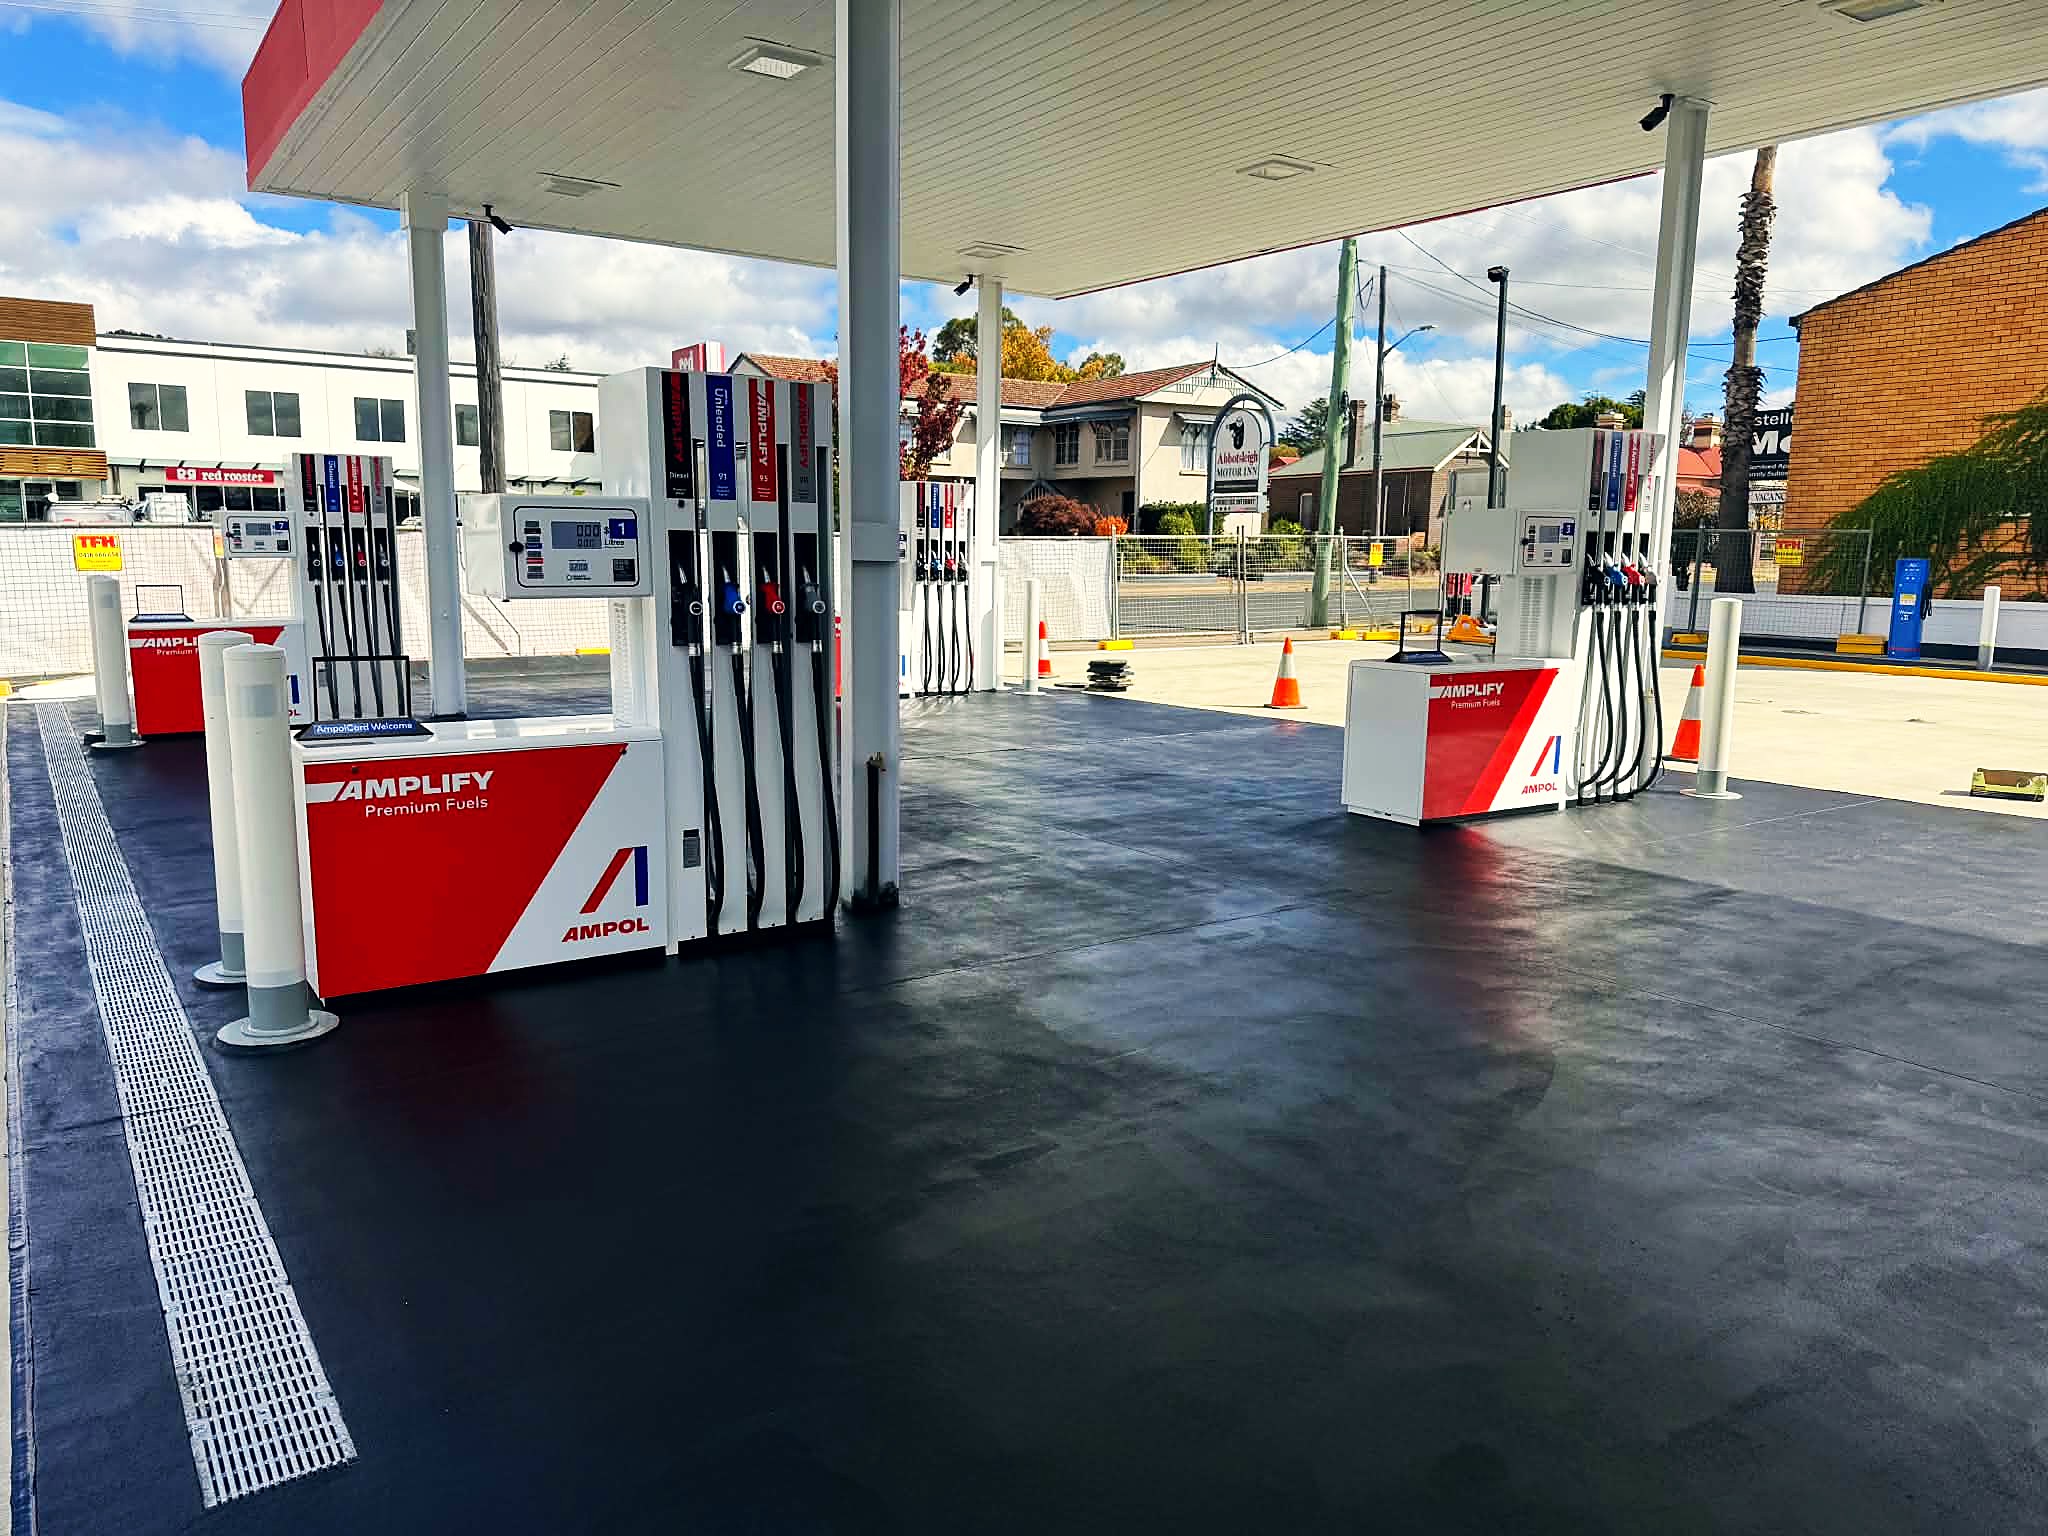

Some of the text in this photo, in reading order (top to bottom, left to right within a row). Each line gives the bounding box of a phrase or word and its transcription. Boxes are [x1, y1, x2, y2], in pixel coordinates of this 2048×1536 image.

[714, 388, 726, 448] Unleaded
[1753, 412, 1793, 426] stell
[756, 394, 769, 467] AMPLIFY
[1216, 450, 1258, 465] Abbotsleigh
[202, 470, 222, 481] red
[224, 471, 265, 482] rooster
[669, 471, 690, 479] Diesel
[718, 472, 728, 481] 91
[1217, 465, 1257, 478] MOTOR INN
[617, 522, 626, 536] 1
[77, 535, 116, 549] TFH
[604, 538, 625, 546] Litres
[143, 636, 199, 648] AMPLI
[156, 647, 193, 656] Premium
[1439, 682, 1505, 699] AMPLIFY
[1450, 697, 1501, 710] Premium Fuels
[315, 722, 413, 735] AmpolCard Welcome
[337, 770, 494, 802] AMPLIFY
[1521, 782, 1558, 795] AMPOL
[365, 796, 489, 818] Premium Fuels
[561, 917, 650, 943] AMPOL
